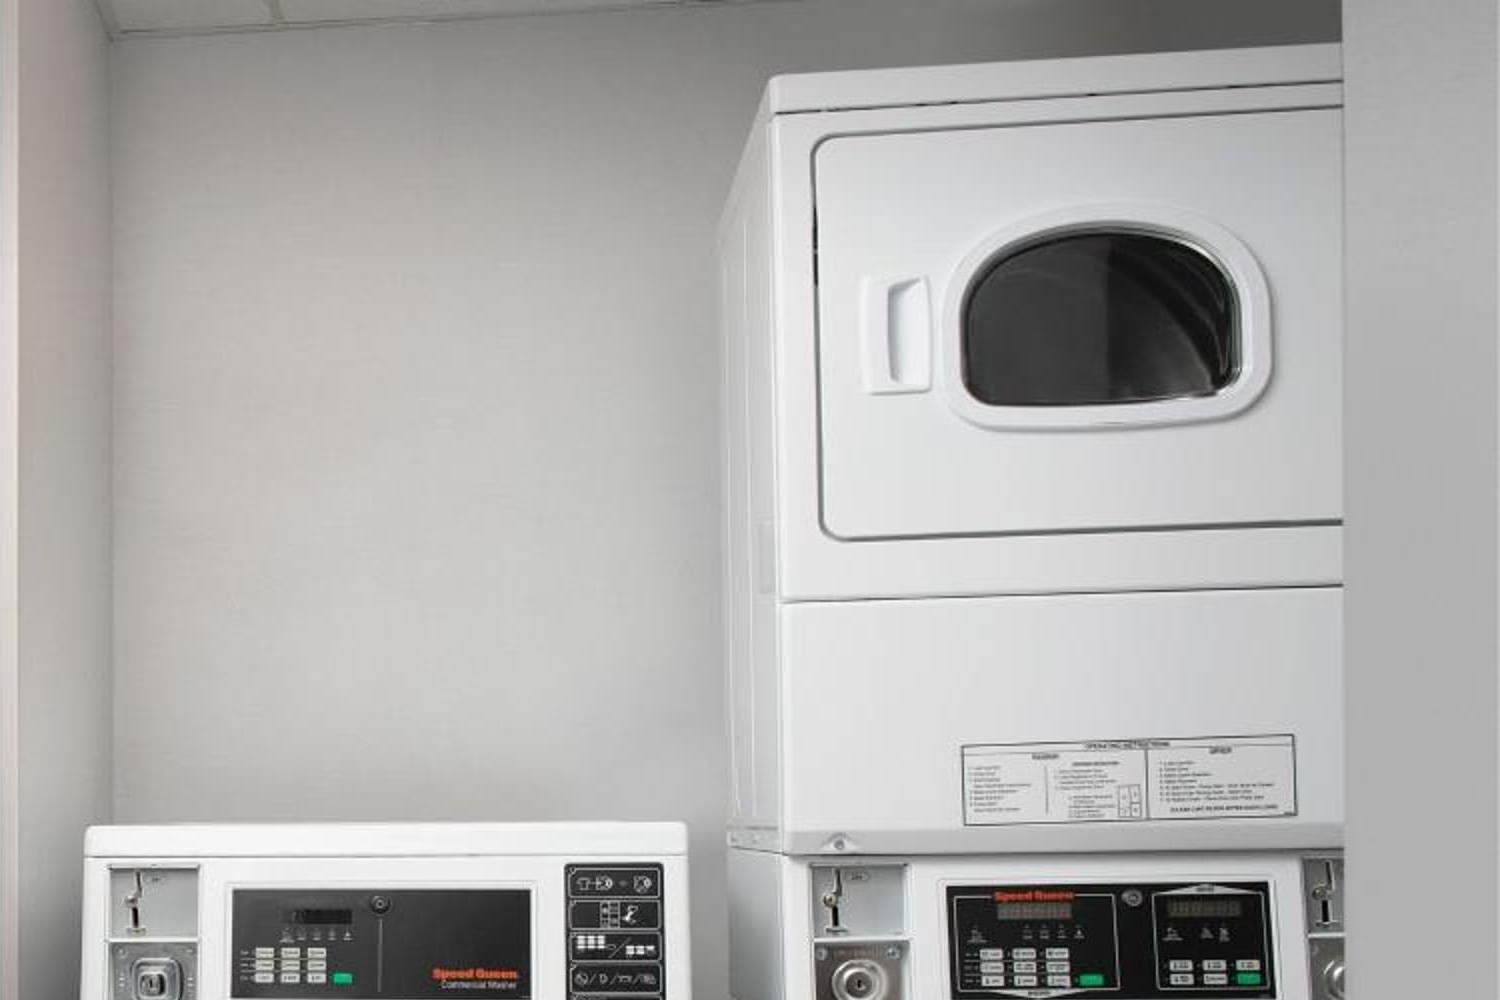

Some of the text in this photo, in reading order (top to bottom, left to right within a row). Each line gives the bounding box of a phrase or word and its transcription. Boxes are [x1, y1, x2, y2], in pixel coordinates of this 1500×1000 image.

[995, 890, 1075, 903] Speed Queen
[432, 968, 518, 980] Speed Queen
[441, 980, 517, 989] Commercial Washer
